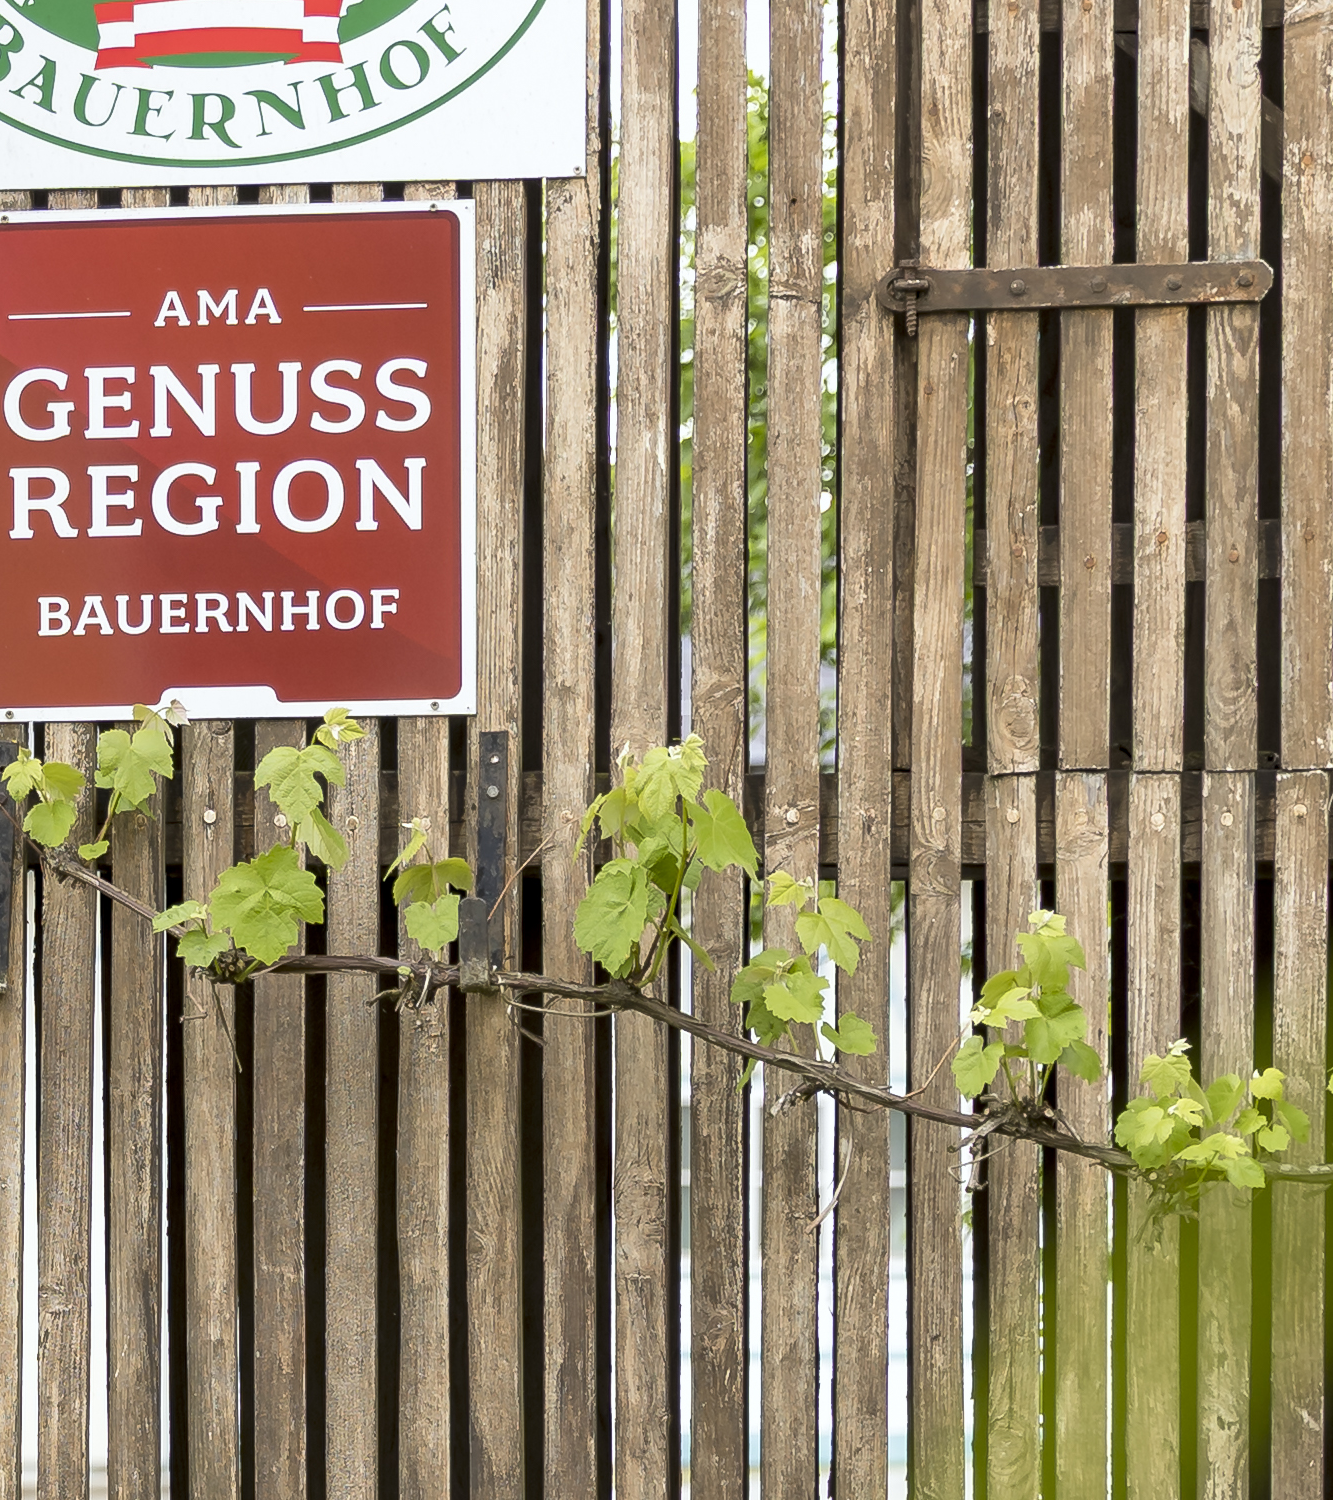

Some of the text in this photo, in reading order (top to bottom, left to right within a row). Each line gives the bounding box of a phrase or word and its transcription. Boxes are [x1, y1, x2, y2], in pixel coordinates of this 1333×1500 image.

[153, 287, 283, 328] AMA
[2, 357, 433, 442] GENUSS
[7, 457, 428, 540] REGION
[36, 588, 400, 638] BAUERNHOF
